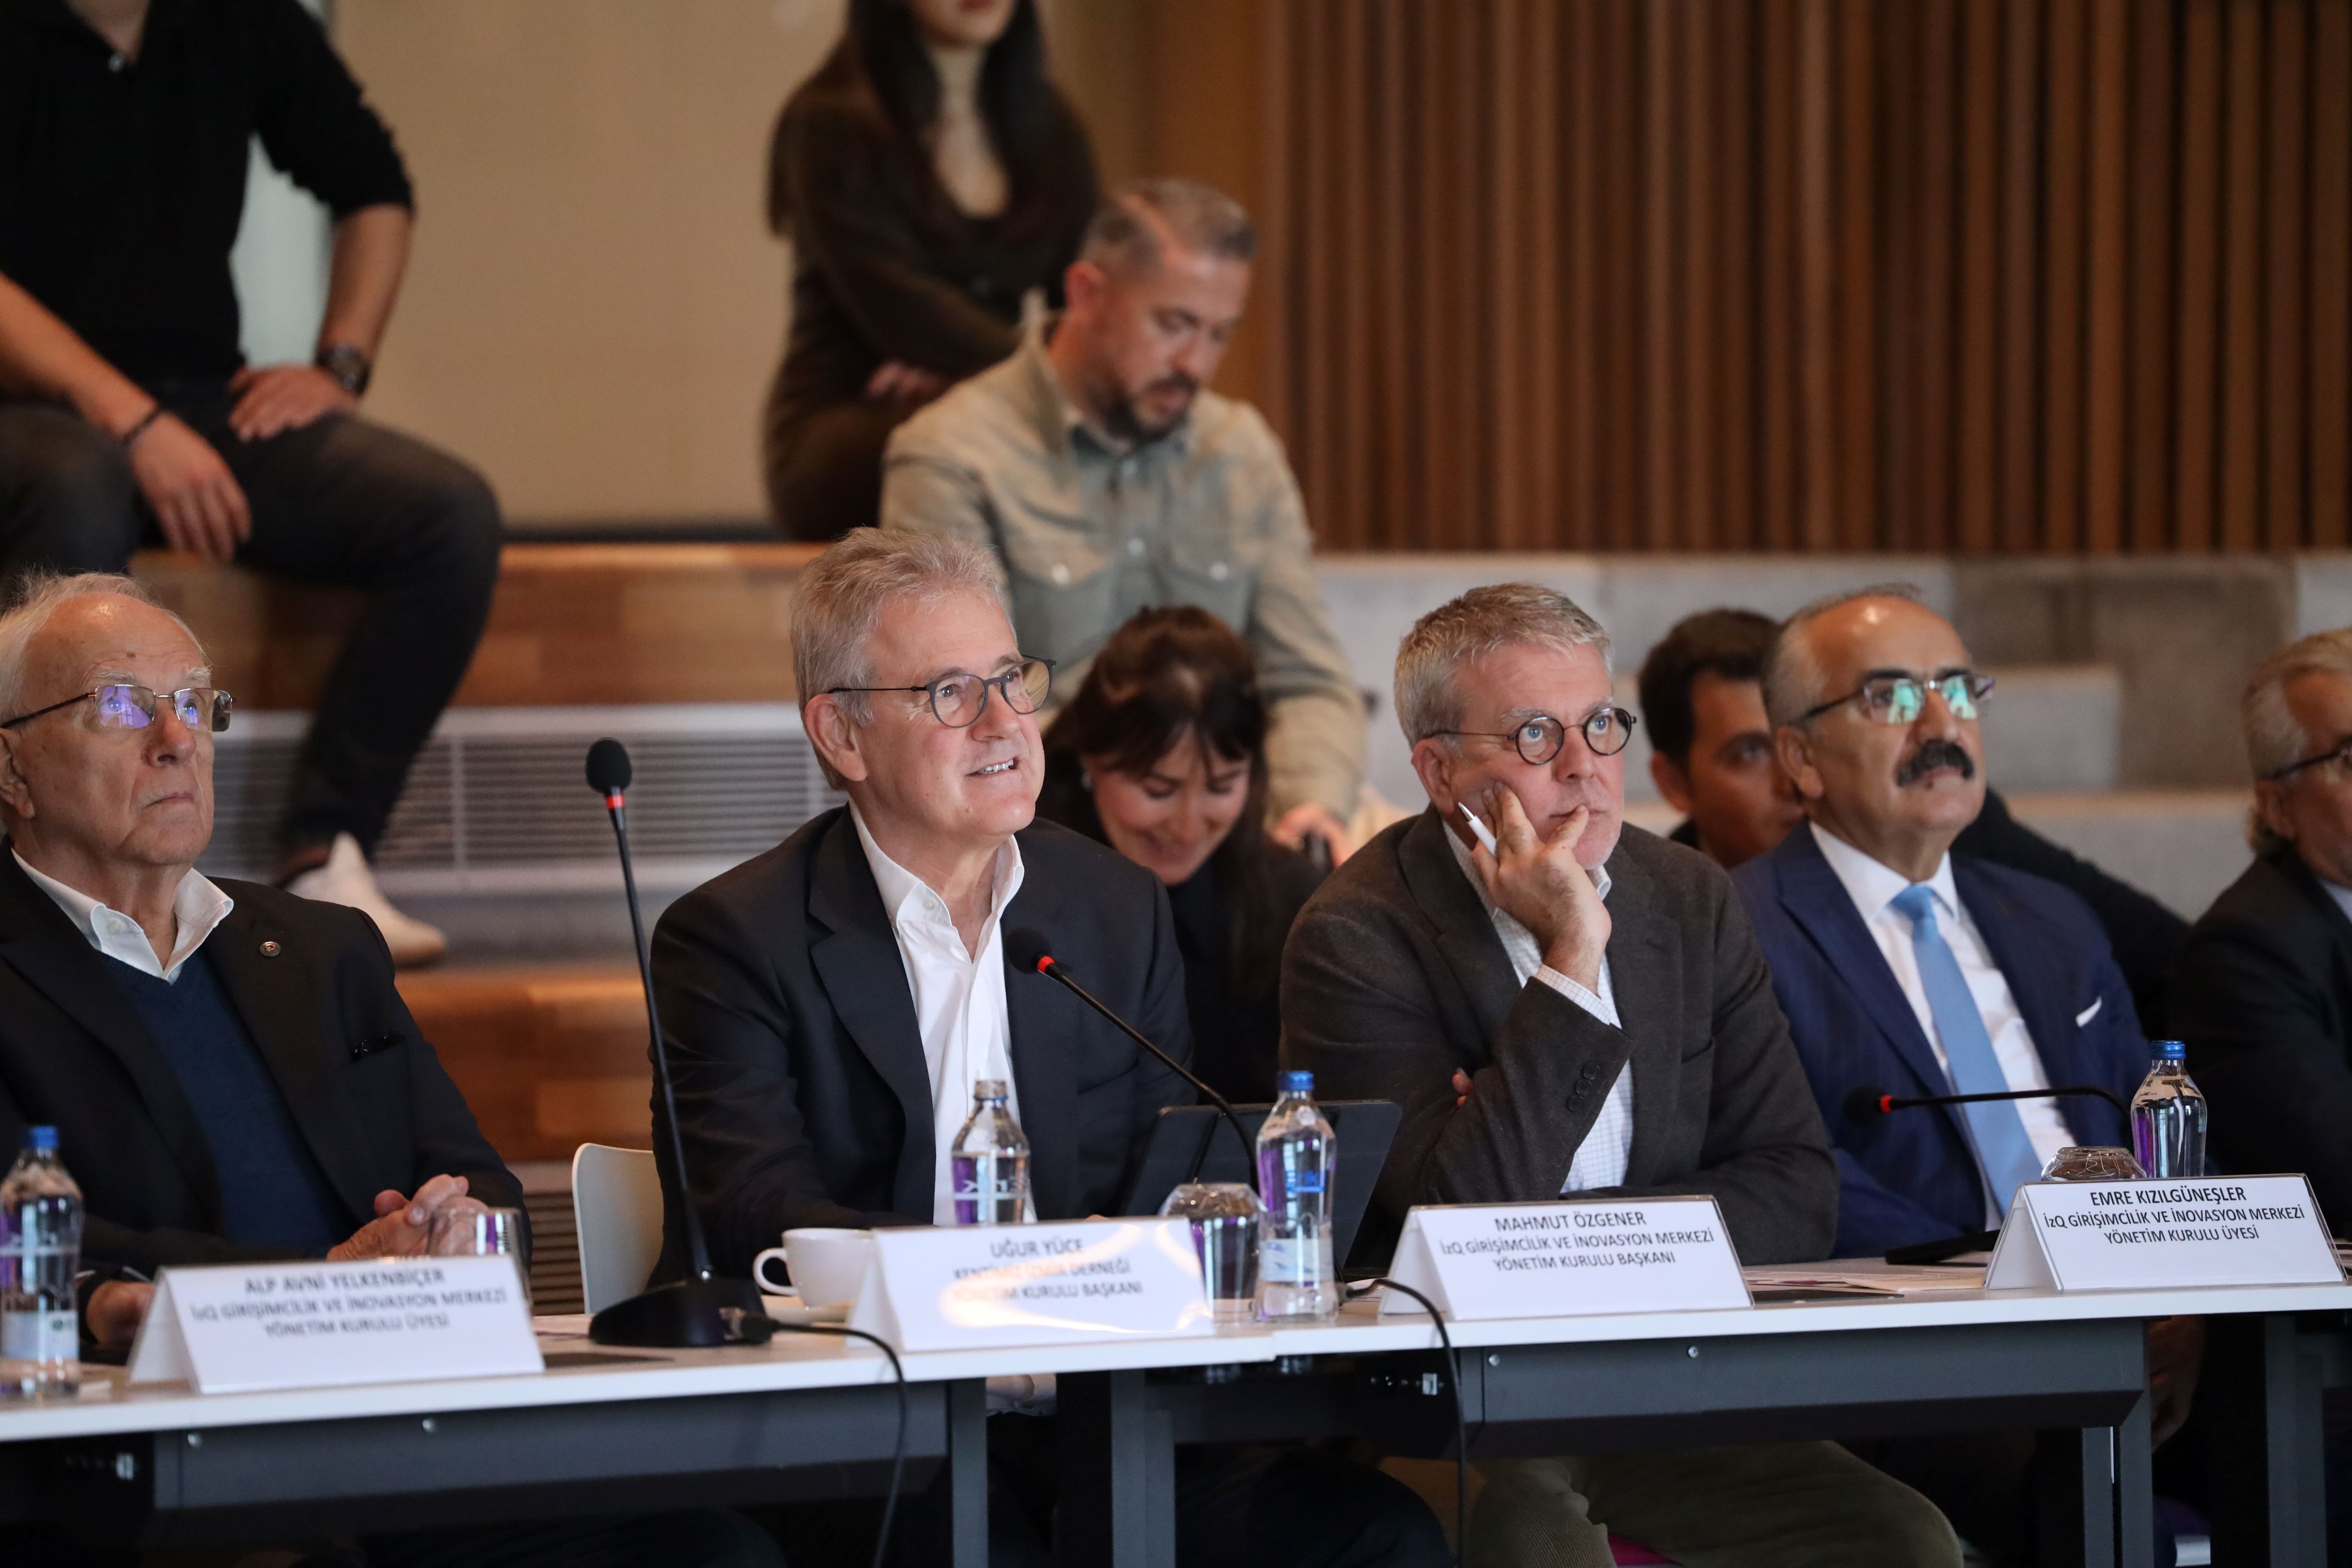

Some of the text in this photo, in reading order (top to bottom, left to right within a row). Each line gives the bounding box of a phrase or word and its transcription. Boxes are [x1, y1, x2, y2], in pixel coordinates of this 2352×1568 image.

[2090, 1186, 2247, 1206] EMRE KIZILGÜNEŞLER
[1494, 1211, 1647, 1232] MAHMUT ÖZGENER
[2043, 1204, 2304, 1228] İzQ GİRİŞİMCİLİK VE İNOVASYON MERKEZİ
[1440, 1227, 1714, 1255] İzQ GİRİŞİMCİLİK VE İNOVASYON MERKEZİ
[2104, 1225, 2259, 1244] YÖNETİM KURULU ÜYESİ
[990, 1237, 1038, 1259] UĞUR
[1070, 1258, 1132, 1277] DERNEĞİ
[1493, 1251, 1675, 1271] YÖNETİM KURULU BAŞKANI
[1021, 1282, 1079, 1299] KURULU
[1082, 1280, 1143, 1299] BAŞKANI
[321, 1297, 343, 1313] VE
